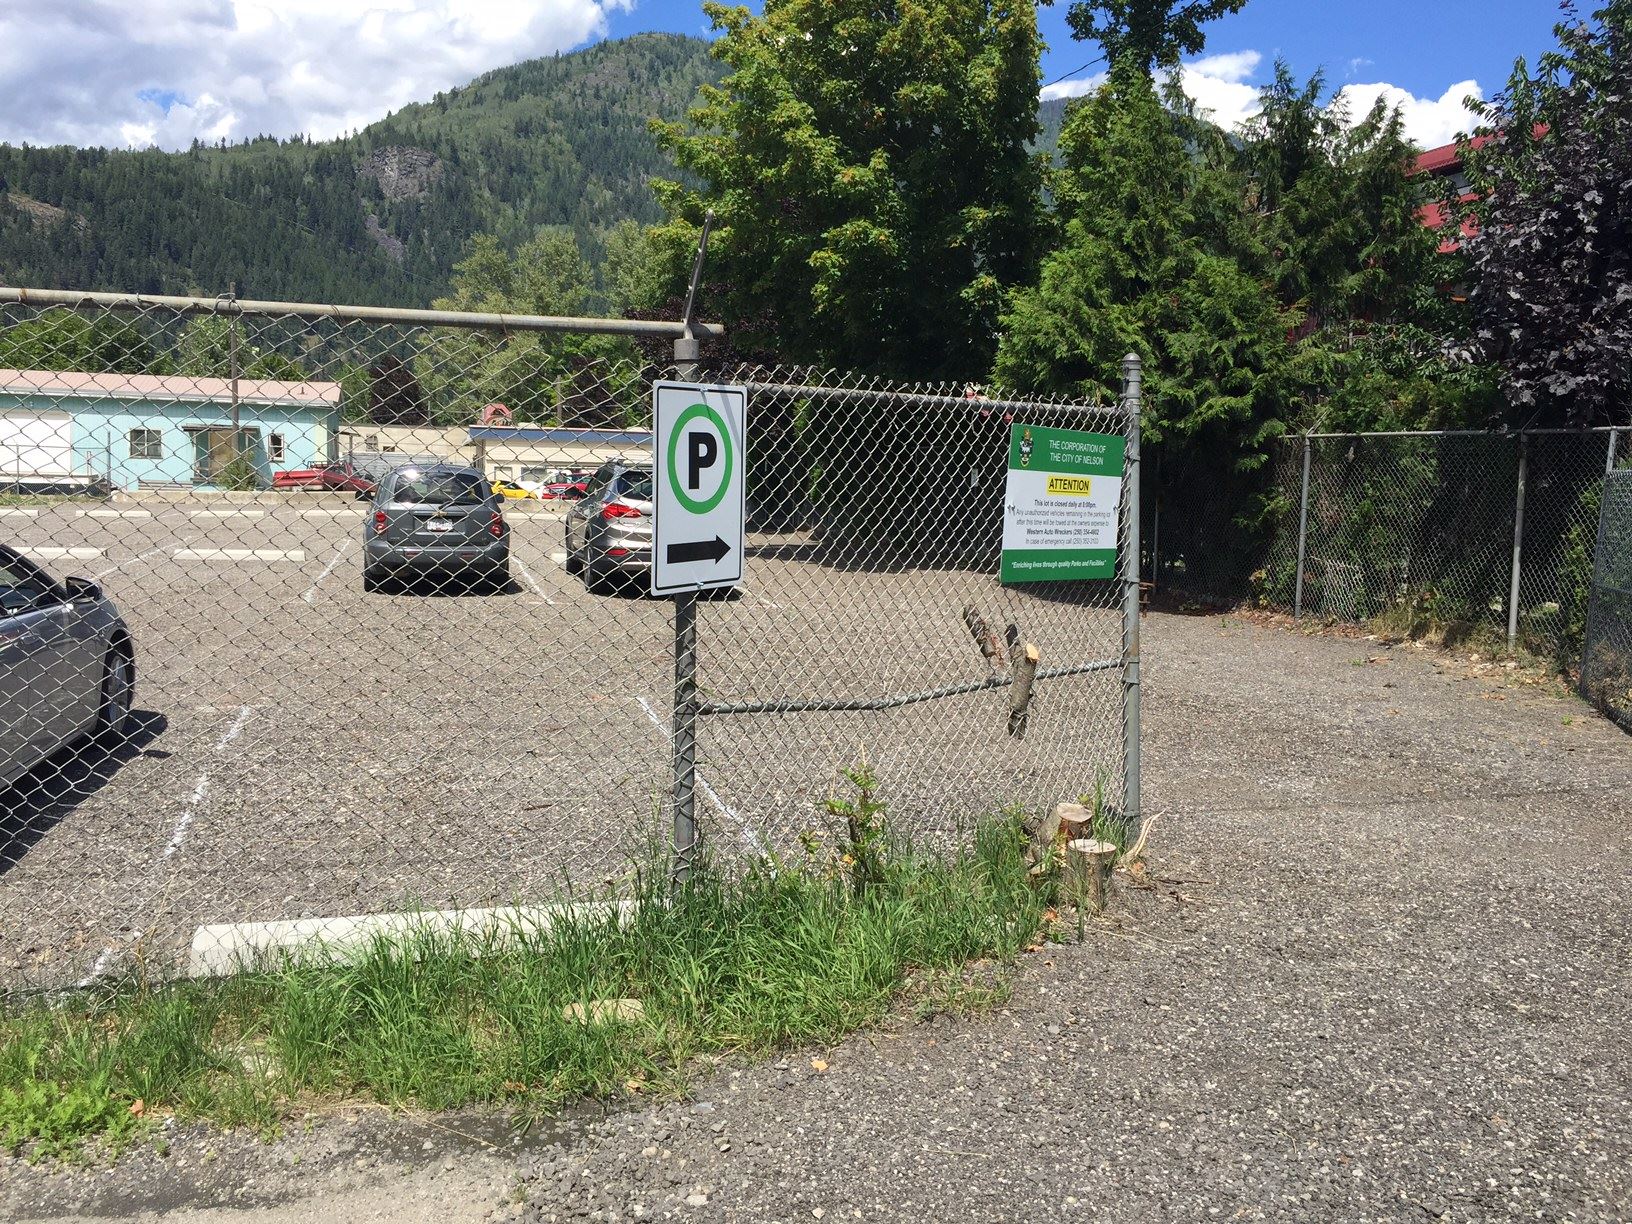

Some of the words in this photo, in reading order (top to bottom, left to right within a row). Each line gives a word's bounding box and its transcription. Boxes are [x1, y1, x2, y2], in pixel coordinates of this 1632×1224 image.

[1049, 440, 1060, 449] THE
[1061, 441, 1098, 453] CORPORATION
[1098, 445, 1106, 454] OF
[688, 431, 718, 490] P
[1050, 452, 1061, 462] THE
[1062, 454, 1074, 462] CITY
[1074, 454, 1082, 463] OF
[1083, 456, 1104, 465] NELSON
[1049, 478, 1089, 490] ATTENTION
[1068, 501, 1077, 509] daily
